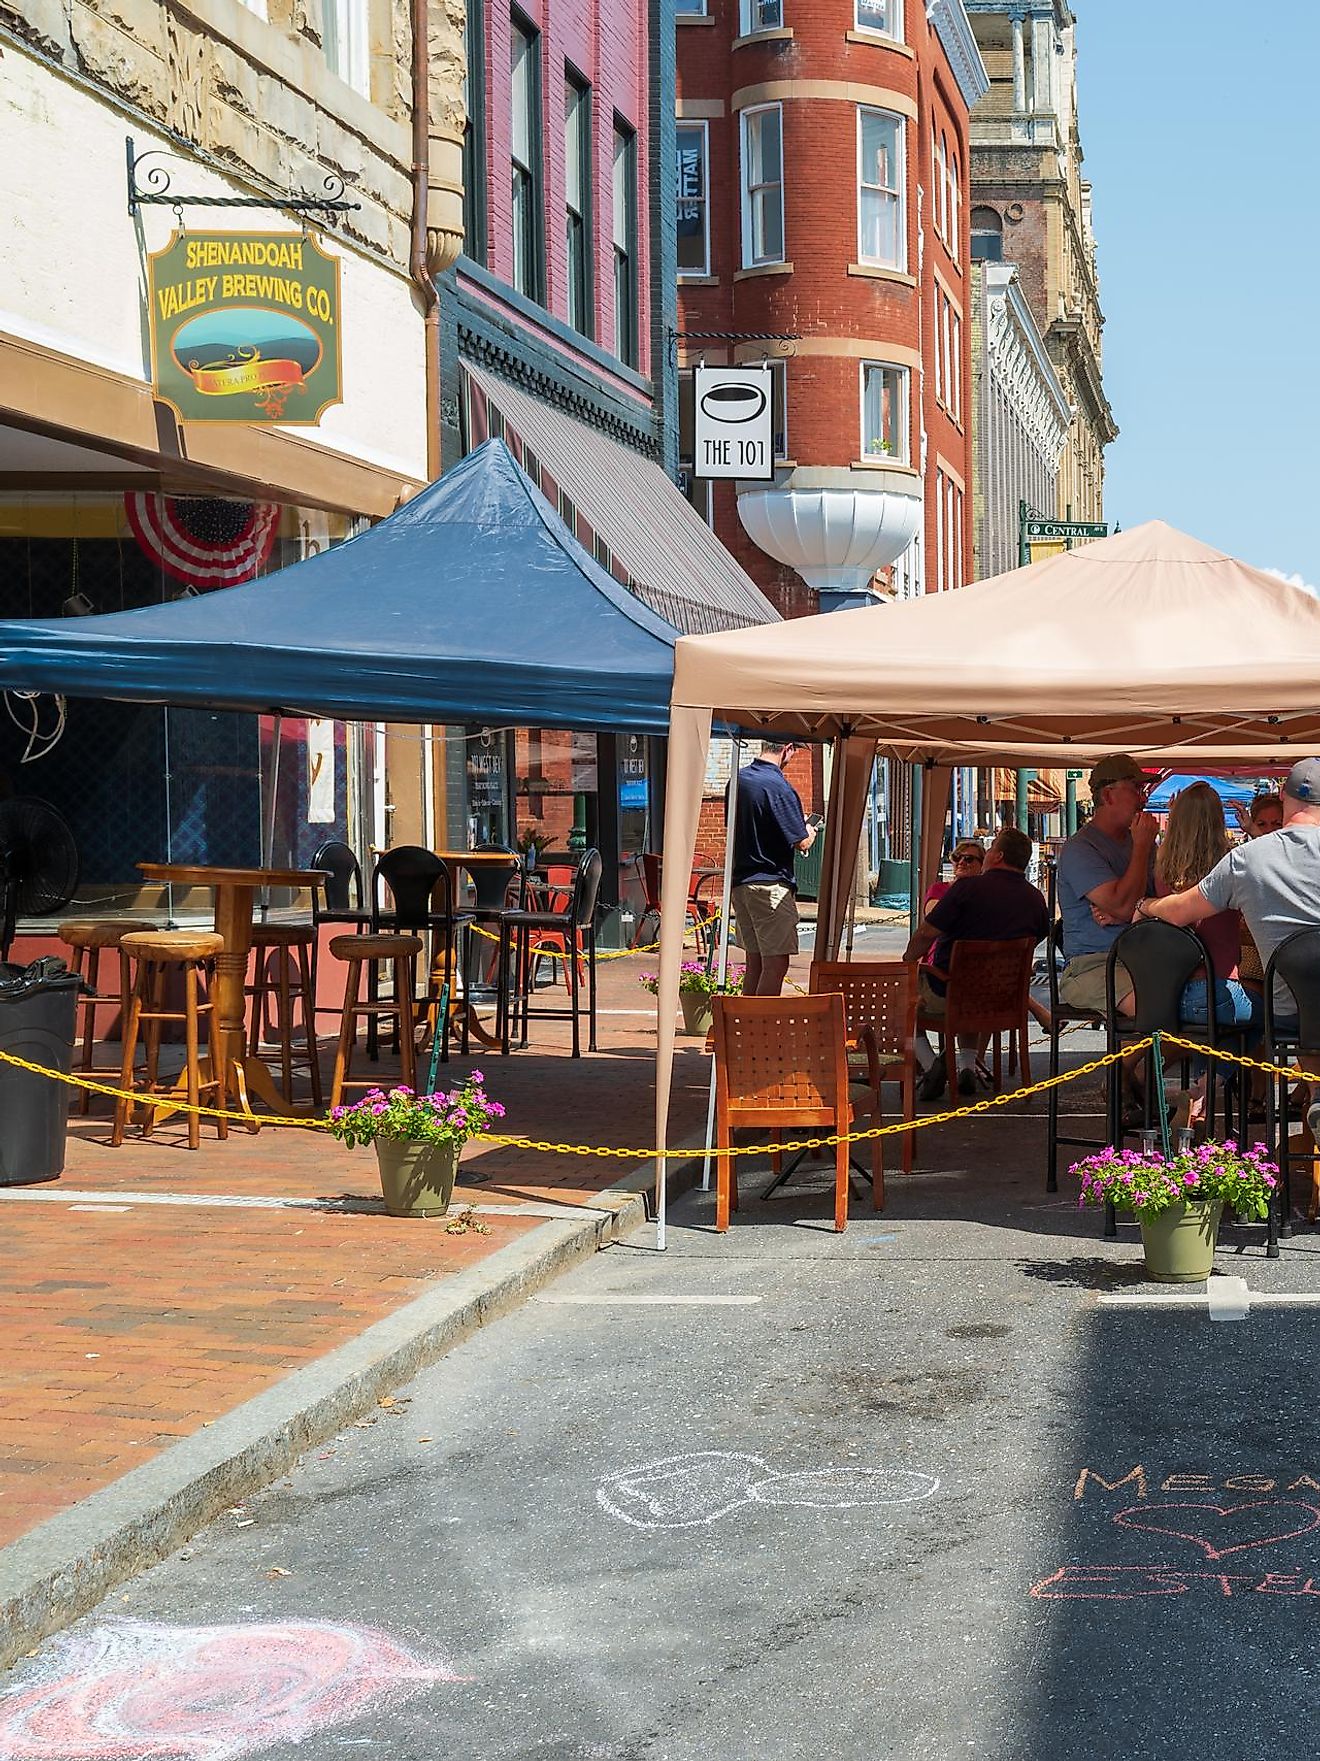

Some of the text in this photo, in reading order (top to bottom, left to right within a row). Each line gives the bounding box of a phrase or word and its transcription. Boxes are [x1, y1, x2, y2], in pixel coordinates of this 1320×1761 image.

[186, 241, 303, 270] SHENANDOAH
[158, 274, 335, 325] VALLEY BREWING CO.
[703, 439, 765, 466] THE 101
[1044, 525, 1090, 537] CENTRAL
